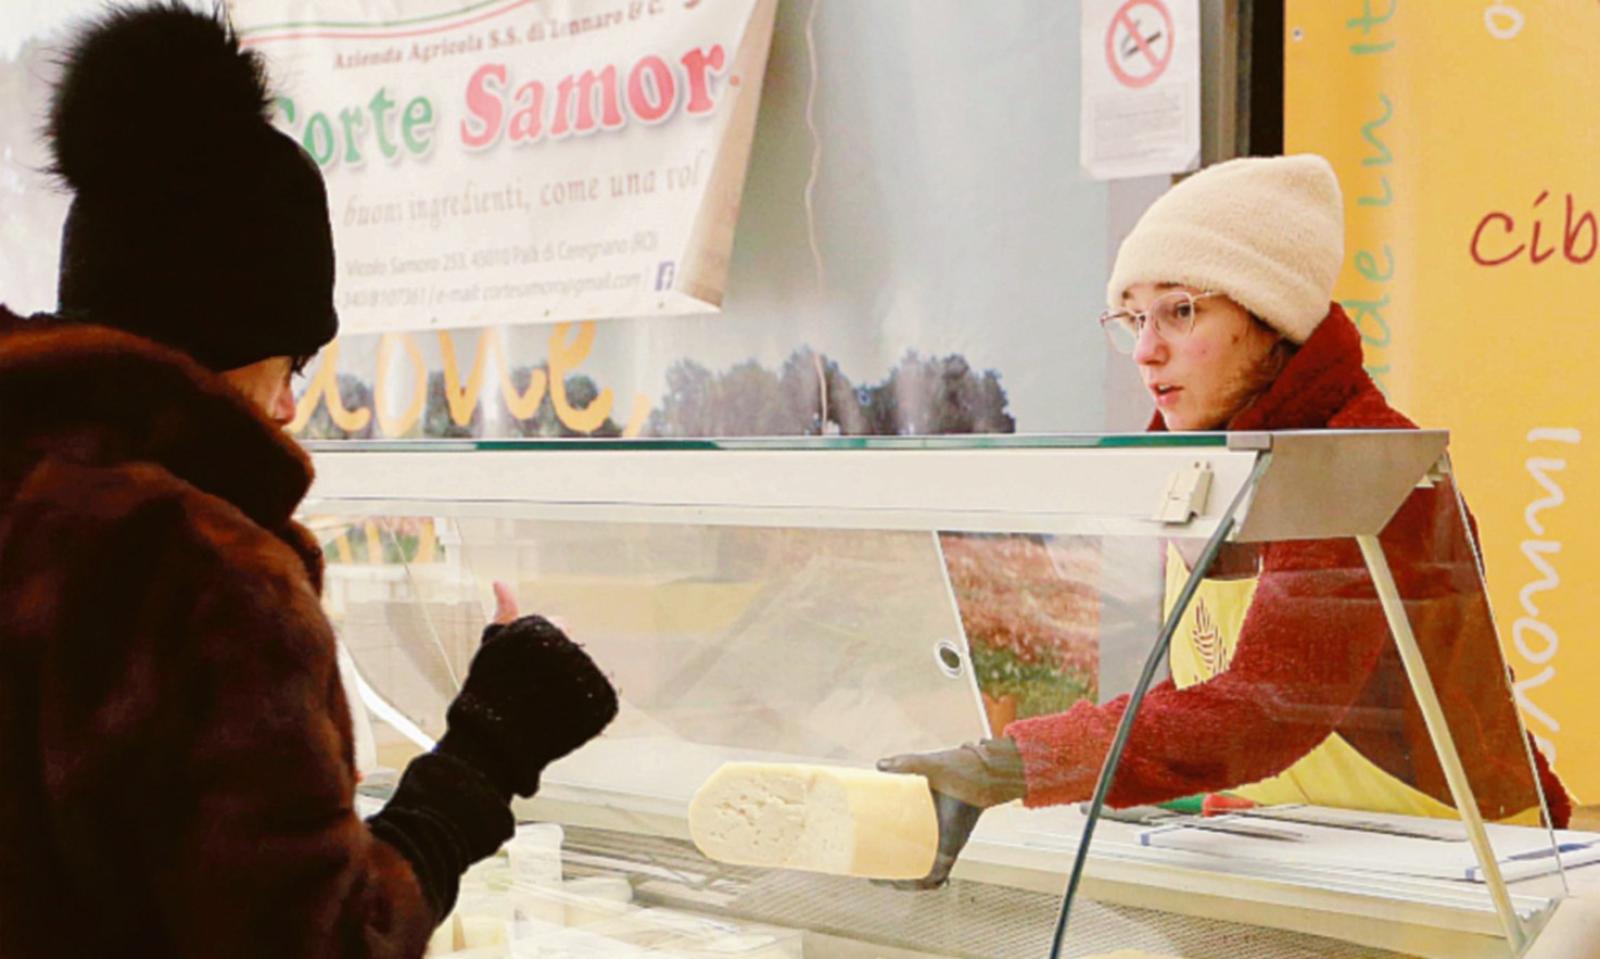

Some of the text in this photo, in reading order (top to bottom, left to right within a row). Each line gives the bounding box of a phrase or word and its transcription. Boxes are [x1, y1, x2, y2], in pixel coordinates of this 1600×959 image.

[334, 46, 403, 70] Azienda
[409, 35, 482, 64] Agricola
[272, 44, 726, 166] orte Samor
[540, 176, 601, 208] come
[609, 170, 656, 198] una
[1470, 189, 1599, 266] cib
